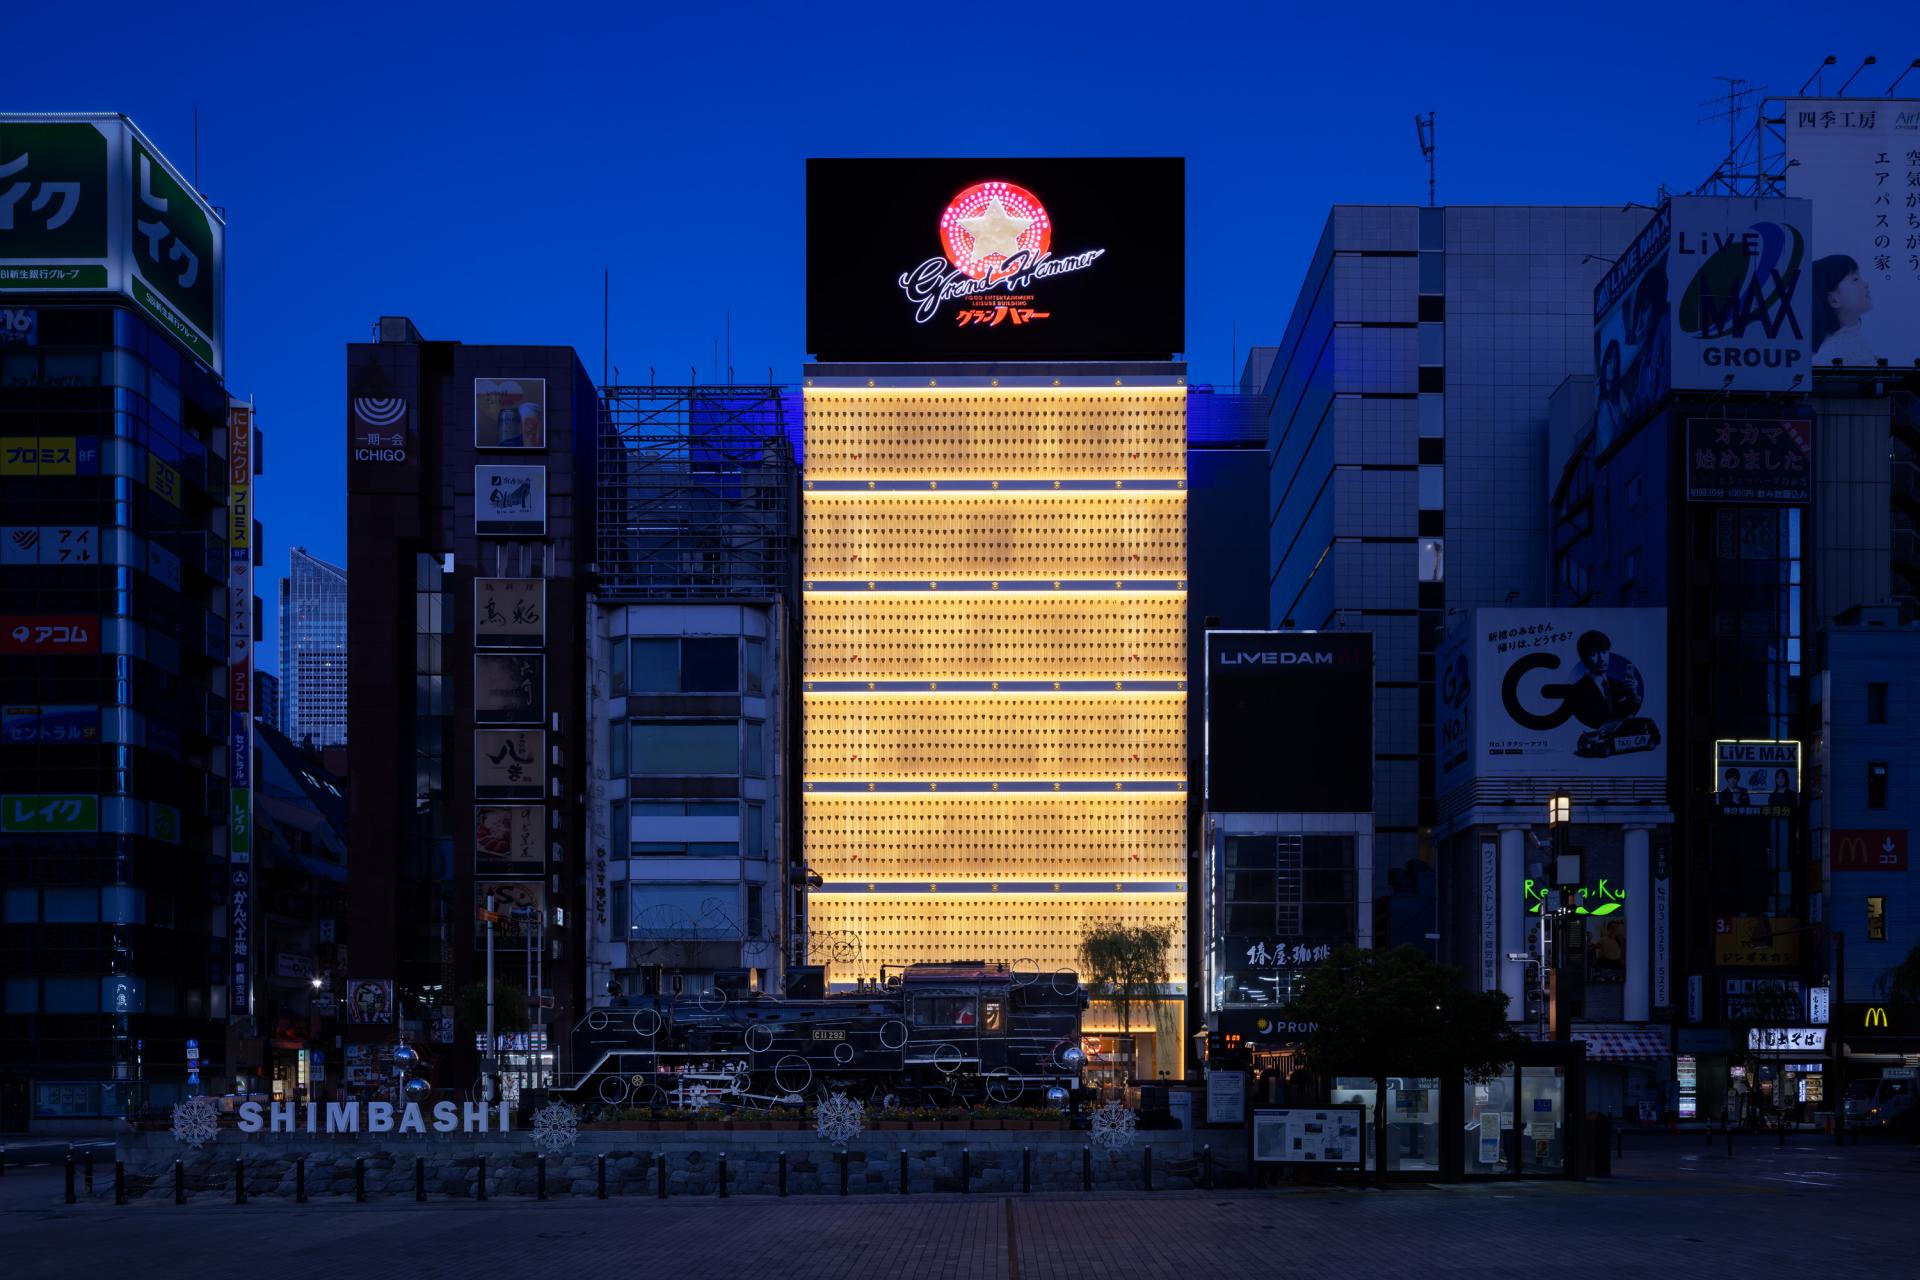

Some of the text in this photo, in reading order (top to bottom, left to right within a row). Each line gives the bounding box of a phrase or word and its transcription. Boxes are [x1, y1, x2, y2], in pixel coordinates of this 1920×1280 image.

[1798, 111, 1877, 130] 四季工房
[1874, 151, 1891, 281] エアパスの家。
[899, 256, 998, 324] Grand
[1701, 267, 1804, 340] MAX
[955, 306, 1051, 327] グランハマー
[1703, 347, 1802, 368] GROUP
[355, 433, 404, 446] 一期一会
[7, 447, 95, 464] プロミス 8F
[354, 449, 406, 463] ICHIGO
[1695, 449, 1805, 472] 始めました
[234, 491, 247, 541] プロミス
[34, 626, 88, 643] アコム
[1488, 622, 1554, 642] 新橋のみなさん
[8, 725, 81, 741] セントラル
[1759, 746, 1797, 761] MAX
[14, 800, 81, 823] レイク
[234, 805, 245, 836] レイク
[233, 890, 248, 955] かんべ土地
[237, 1100, 510, 1135] SHIMBASHI
